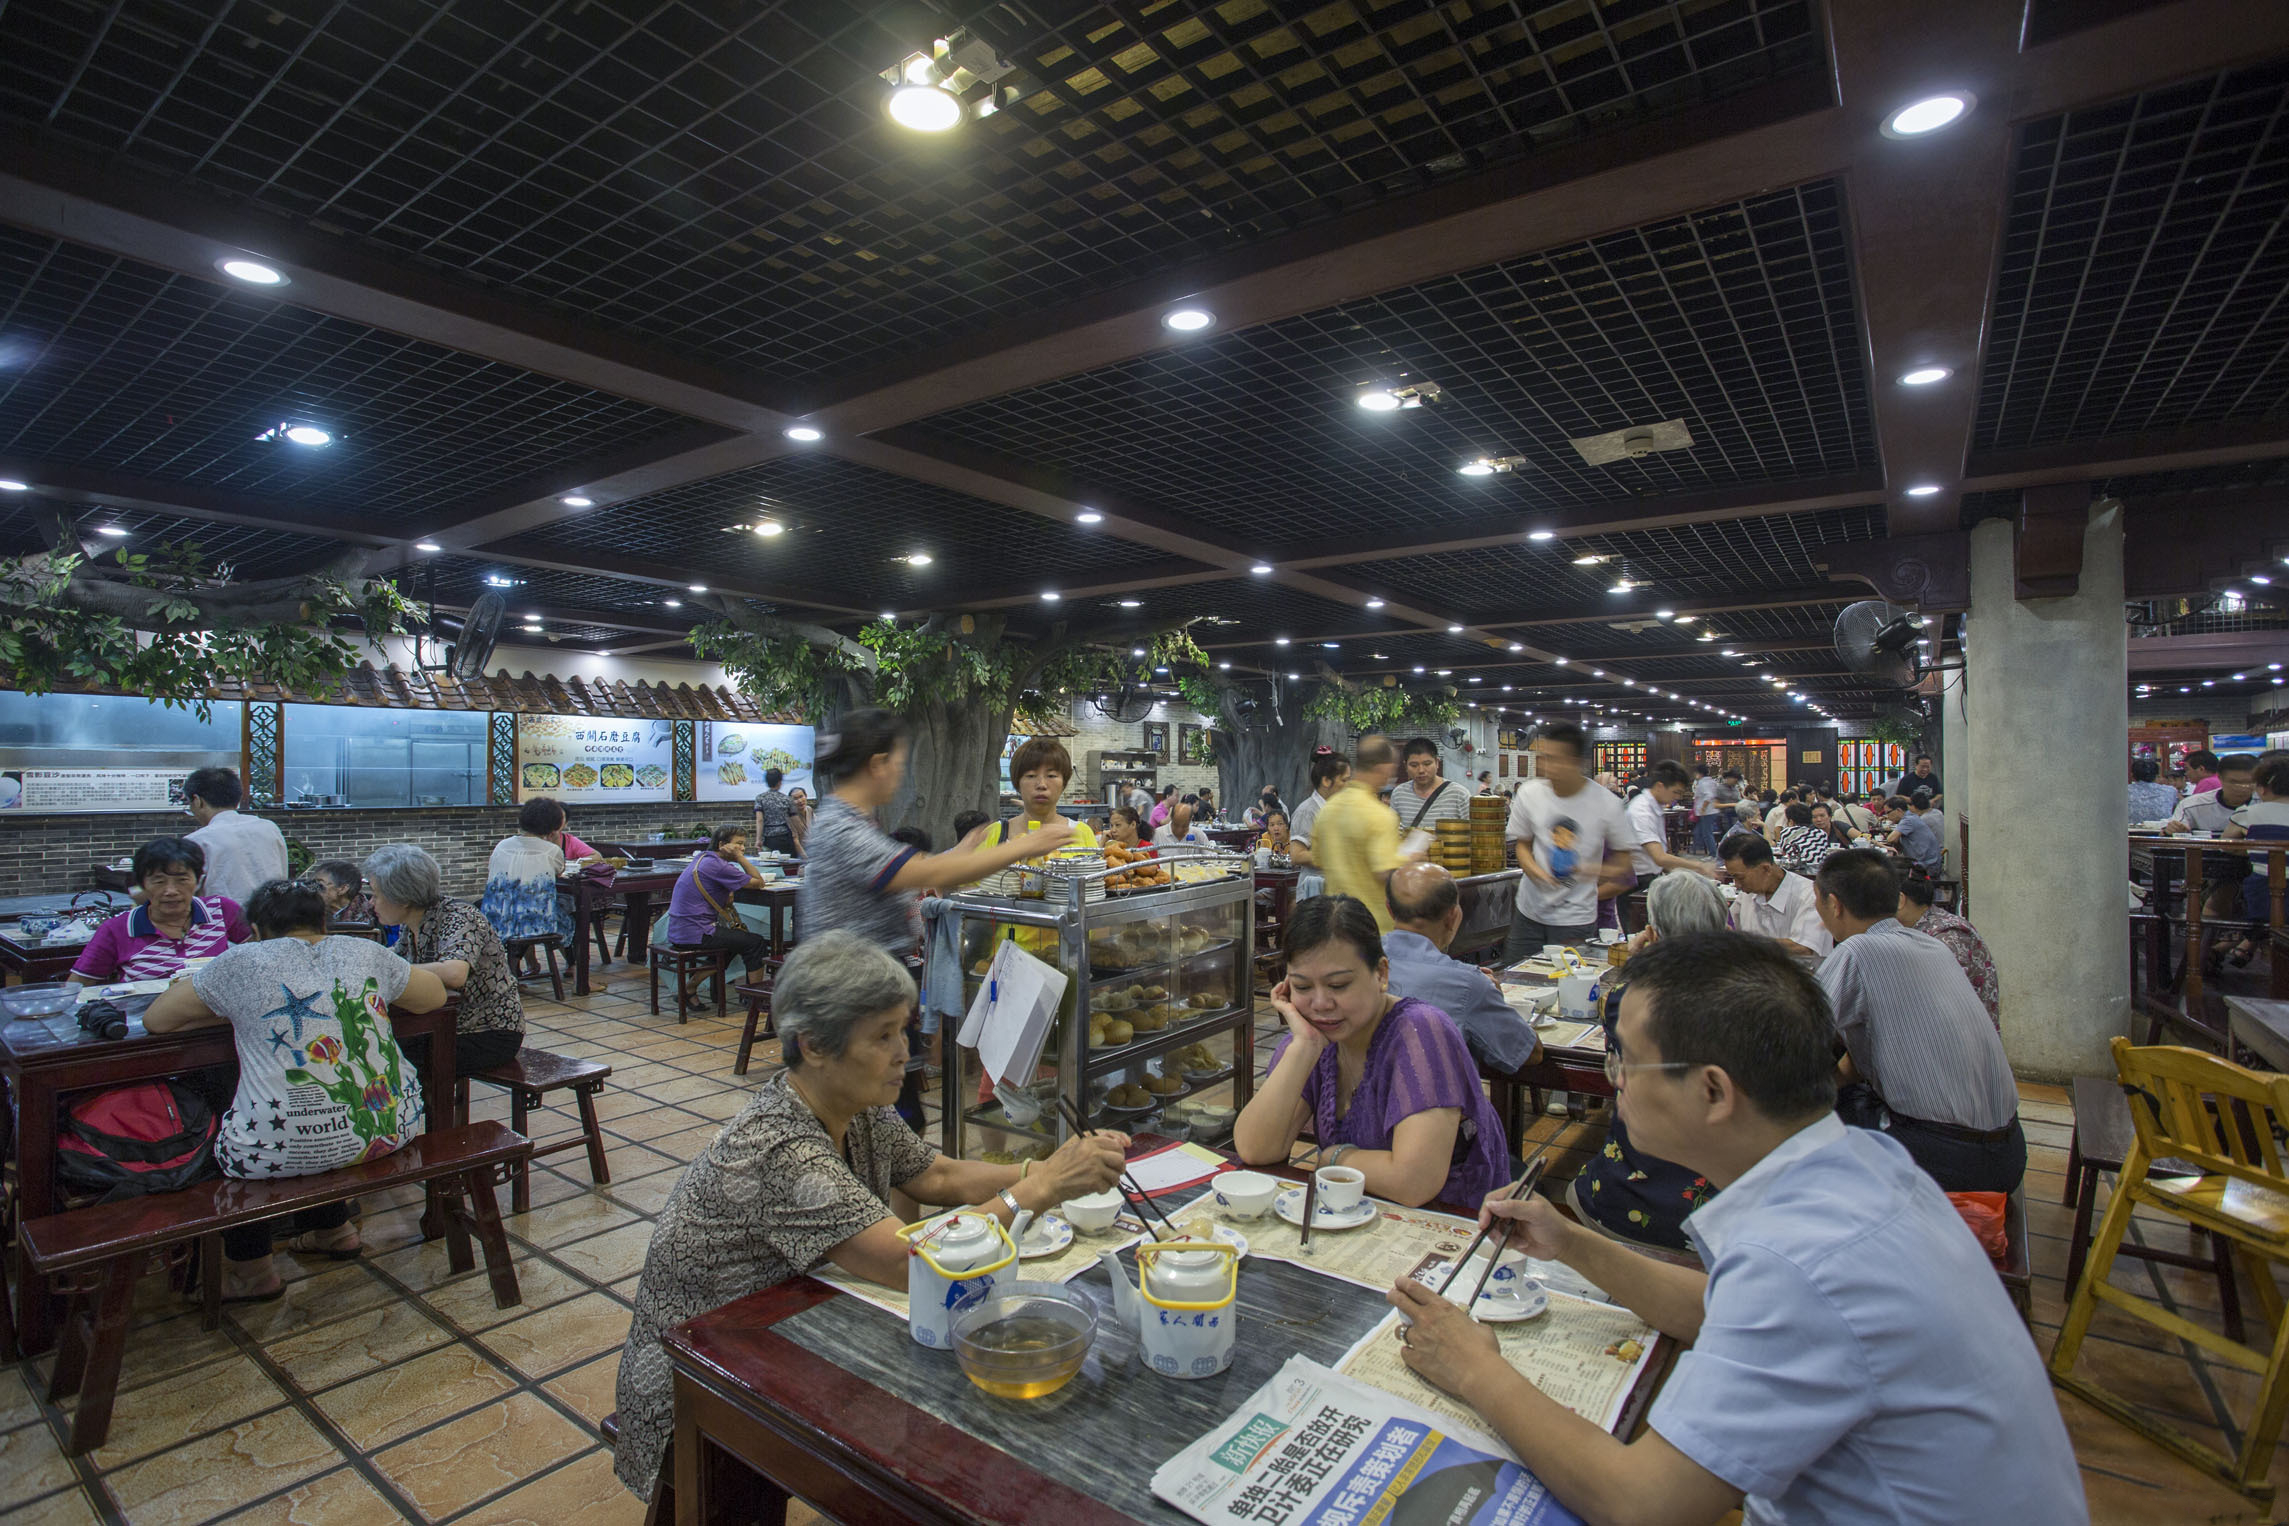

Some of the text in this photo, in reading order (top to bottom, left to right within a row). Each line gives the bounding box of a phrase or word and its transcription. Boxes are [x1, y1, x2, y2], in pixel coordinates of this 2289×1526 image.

[286, 1105, 347, 1117] underwater
[296, 1114, 349, 1136] world
[1219, 1418, 1281, 1467] 新快报
[1227, 1404, 1345, 1519] 单独二胎是否放开
[1251, 1414, 1372, 1526] 卫计委正在研究
